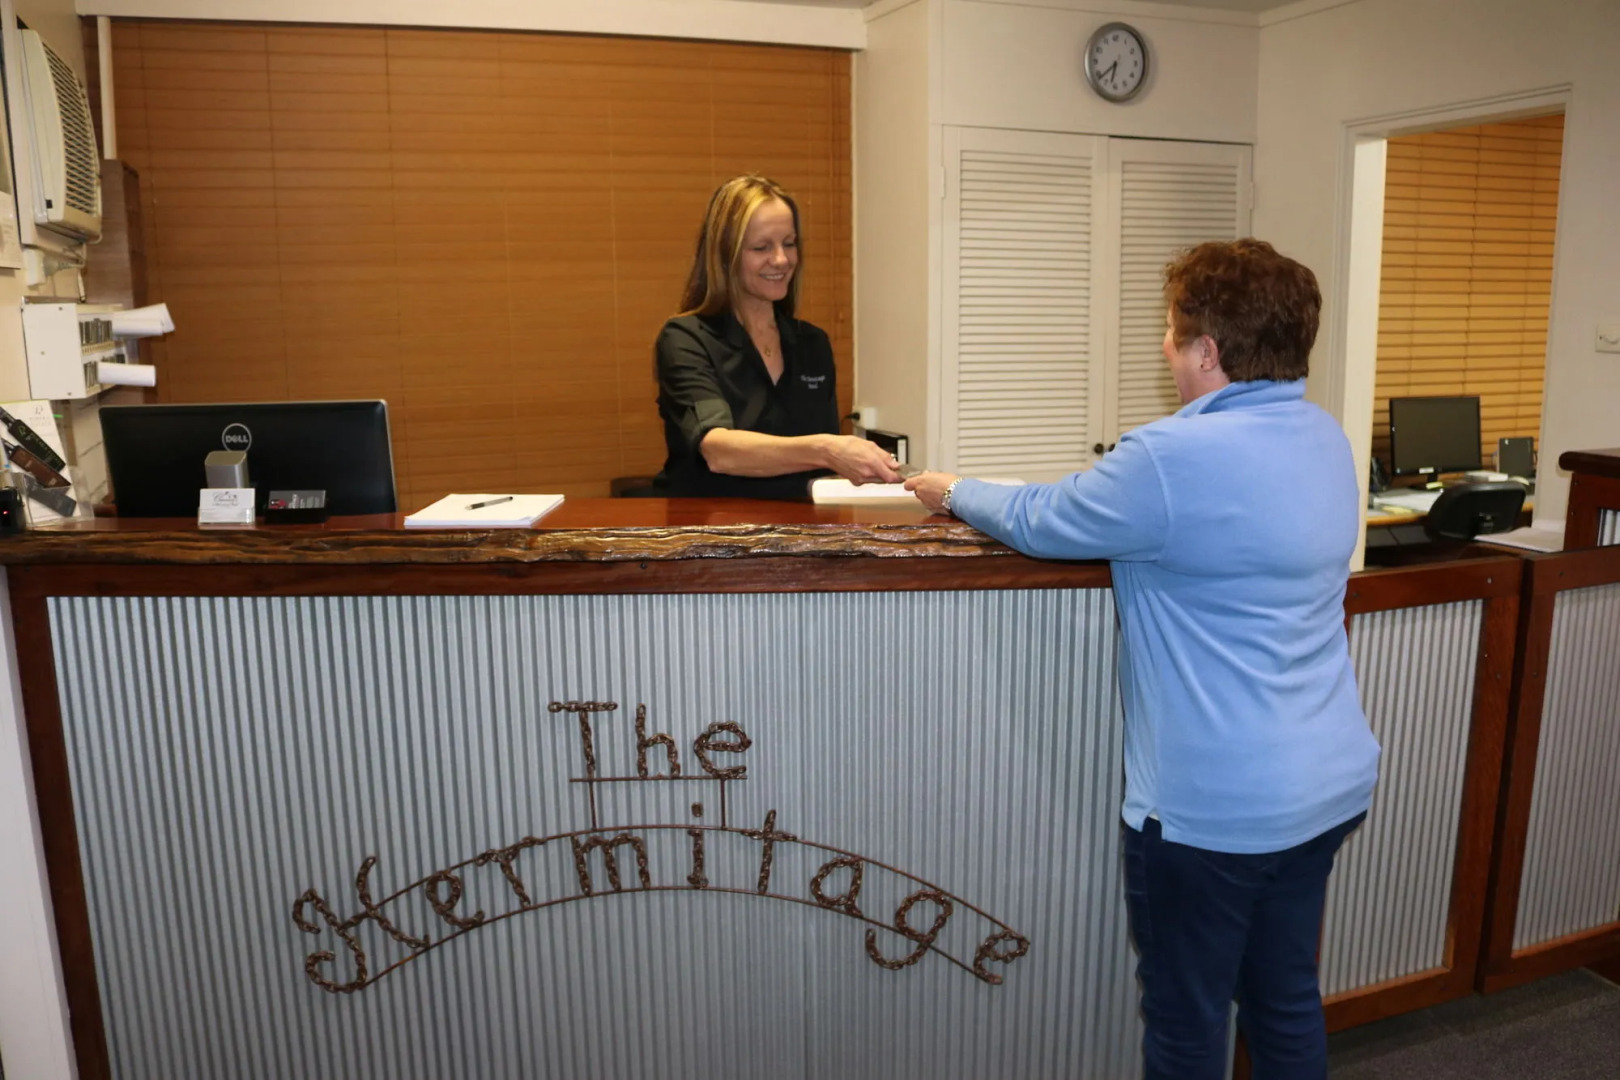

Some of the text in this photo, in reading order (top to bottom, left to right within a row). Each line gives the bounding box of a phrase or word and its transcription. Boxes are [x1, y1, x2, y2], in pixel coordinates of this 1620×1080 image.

[225, 434, 248, 443] DELL
[548, 702, 751, 780] The
[293, 803, 1030, 994] Hermitage
